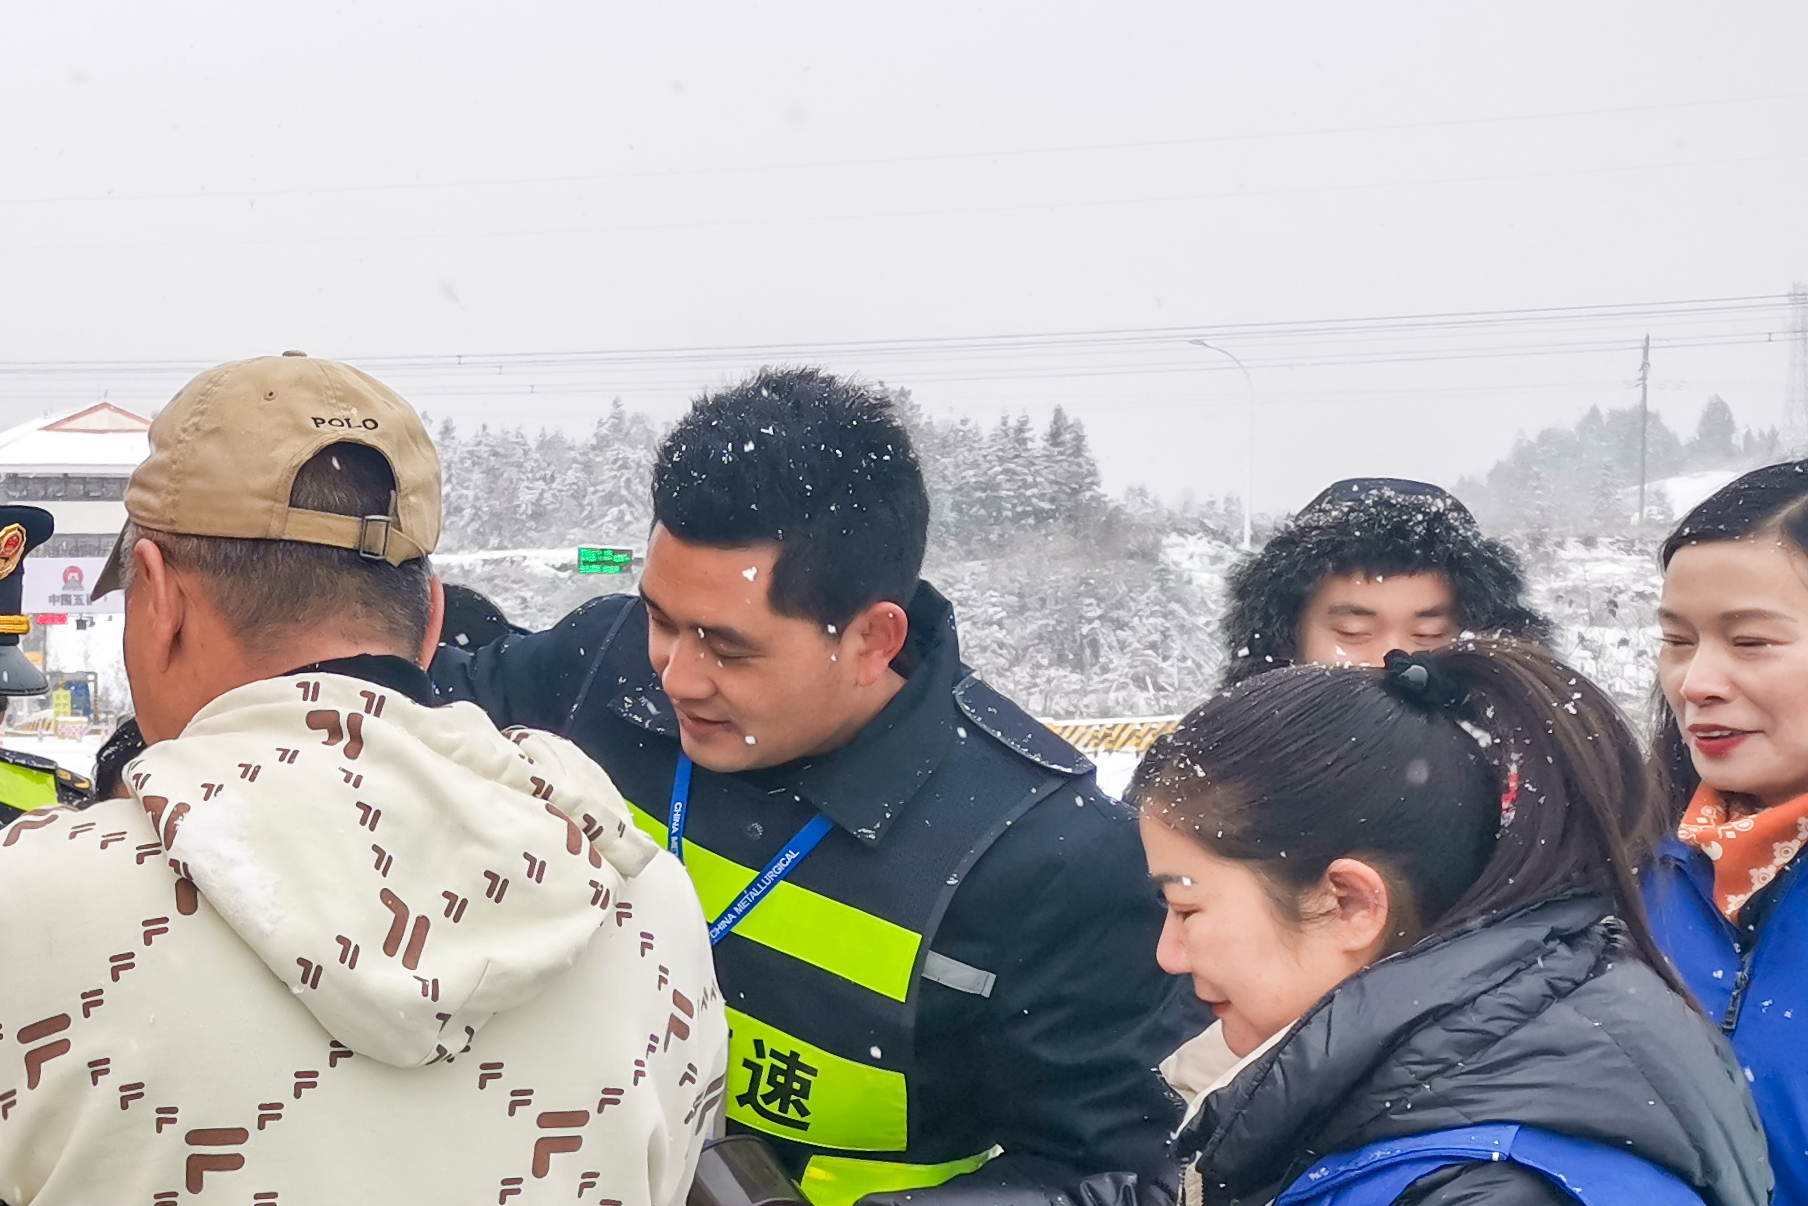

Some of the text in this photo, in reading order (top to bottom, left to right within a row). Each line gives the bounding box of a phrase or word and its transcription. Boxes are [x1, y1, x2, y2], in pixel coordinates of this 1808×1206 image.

[311, 416, 379, 430] POLO
[670, 801, 683, 834] CHINA
[709, 849, 800, 939] CHINA METALLURGICAL
[735, 1039, 818, 1131] 速
